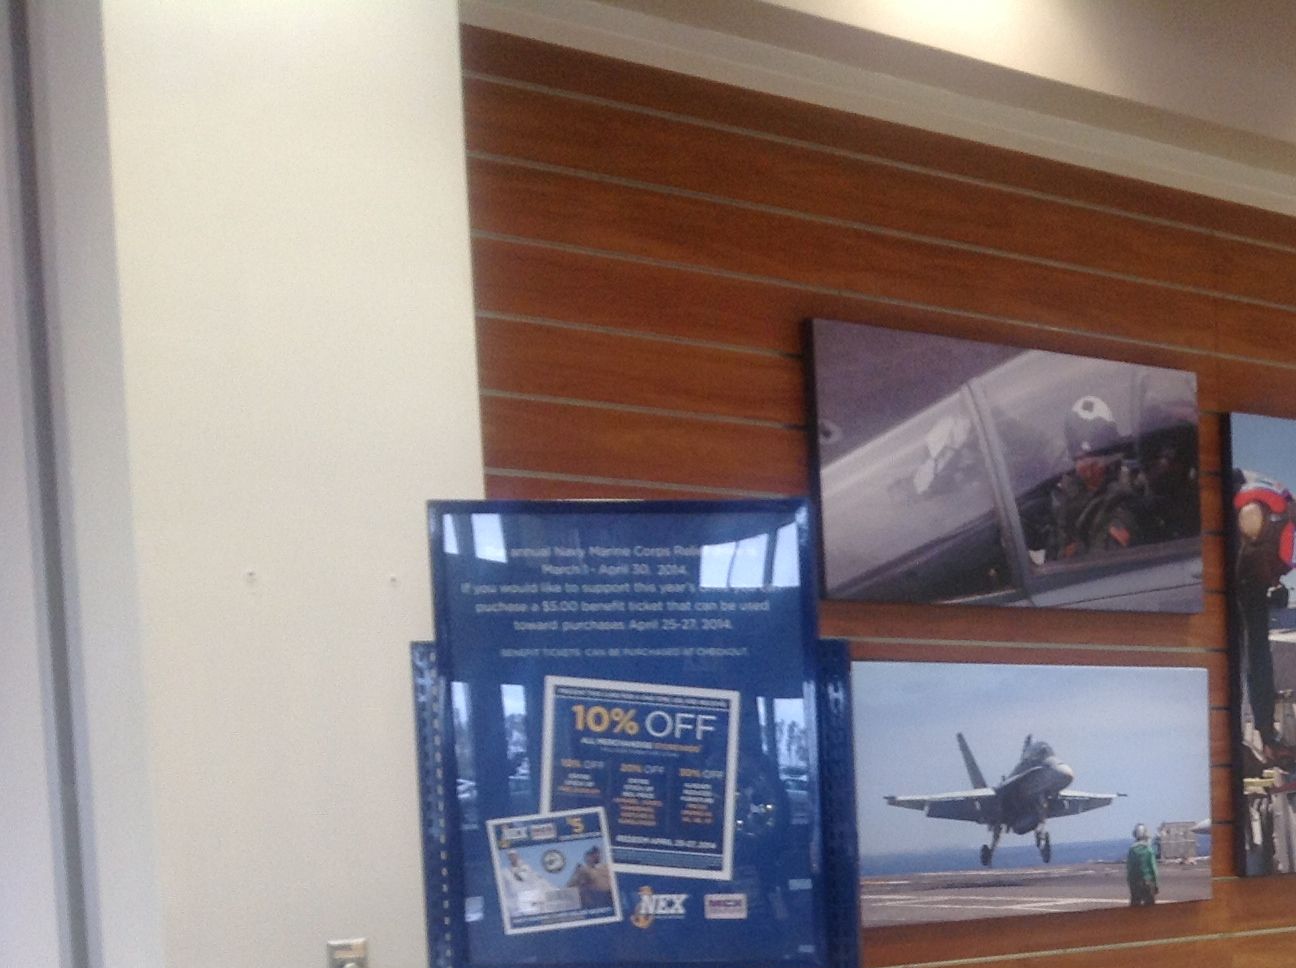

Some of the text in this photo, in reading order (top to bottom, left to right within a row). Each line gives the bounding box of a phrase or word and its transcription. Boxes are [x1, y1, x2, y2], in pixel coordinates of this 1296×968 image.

[510, 548, 550, 557] annual
[553, 546, 585, 559] Navy
[588, 546, 631, 557] Marine
[633, 546, 670, 558] Corps
[541, 563, 582, 575] March
[599, 563, 630, 577] April
[472, 585, 497, 596] you
[500, 583, 539, 594] would
[540, 582, 562, 594] like
[565, 583, 580, 594] to
[582, 583, 630, 596] support
[633, 583, 657, 593] this
[542, 601, 578, 612] $5.00
[580, 602, 625, 612] benefit
[628, 602, 663, 611] ticket
[666, 602, 692, 611] that
[694, 603, 717, 611] can
[719, 602, 736, 611] be
[738, 602, 770, 611] used
[513, 621, 559, 630] toward
[562, 621, 624, 632] purchases
[628, 619, 658, 632] April
[571, 704, 718, 741] 10% OFF
[640, 892, 688, 915] NEX
